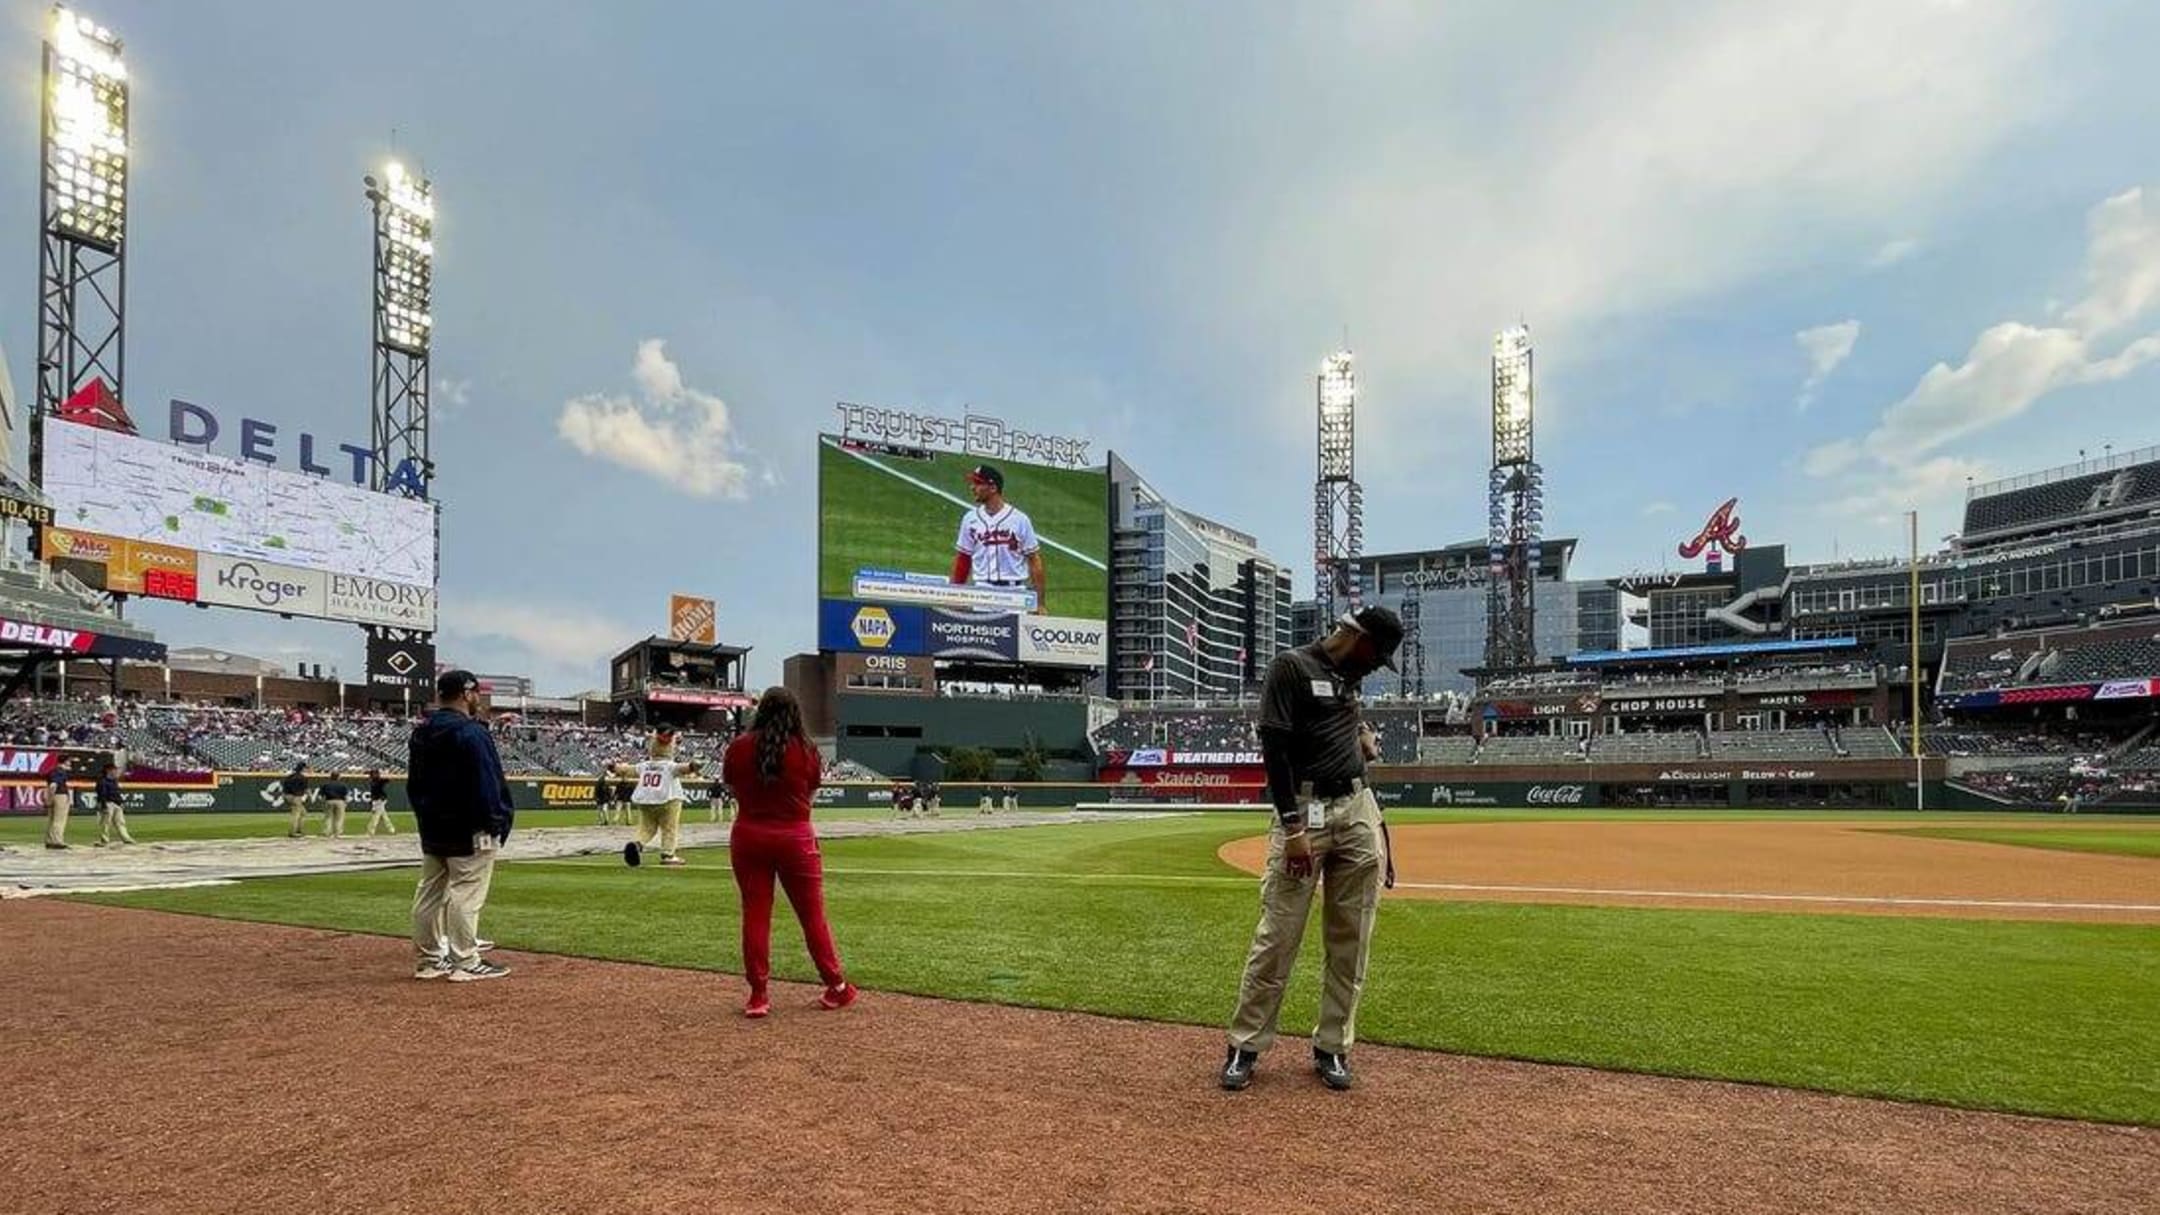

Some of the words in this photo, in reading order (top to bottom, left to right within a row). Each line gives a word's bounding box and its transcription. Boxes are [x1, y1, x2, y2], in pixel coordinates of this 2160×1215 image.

[836, 402, 959, 446] TRUIST
[1011, 429, 1091, 467] PARK
[169, 399, 428, 497] DELTA
[217, 562, 307, 606] Kroger
[331, 575, 430, 608] EMORY
[0, 621, 79, 648] DELAY
[858, 618, 889, 637] NAPA
[932, 621, 1013, 638] NORTHSIDE
[945, 635, 998, 646] HOSPITAL
[1031, 628, 1101, 646] COOLRAY
[865, 656, 907, 670] ORIS
[1610, 700, 1650, 712] CHOP
[1655, 698, 1707, 710] HOUSE
[1760, 695, 1789, 704] MADE
[1793, 695, 1807, 703] TO
[1533, 705, 1566, 714] LIGHT
[1172, 752, 1236, 764] WEATHER
[643, 773, 662, 788] 00
